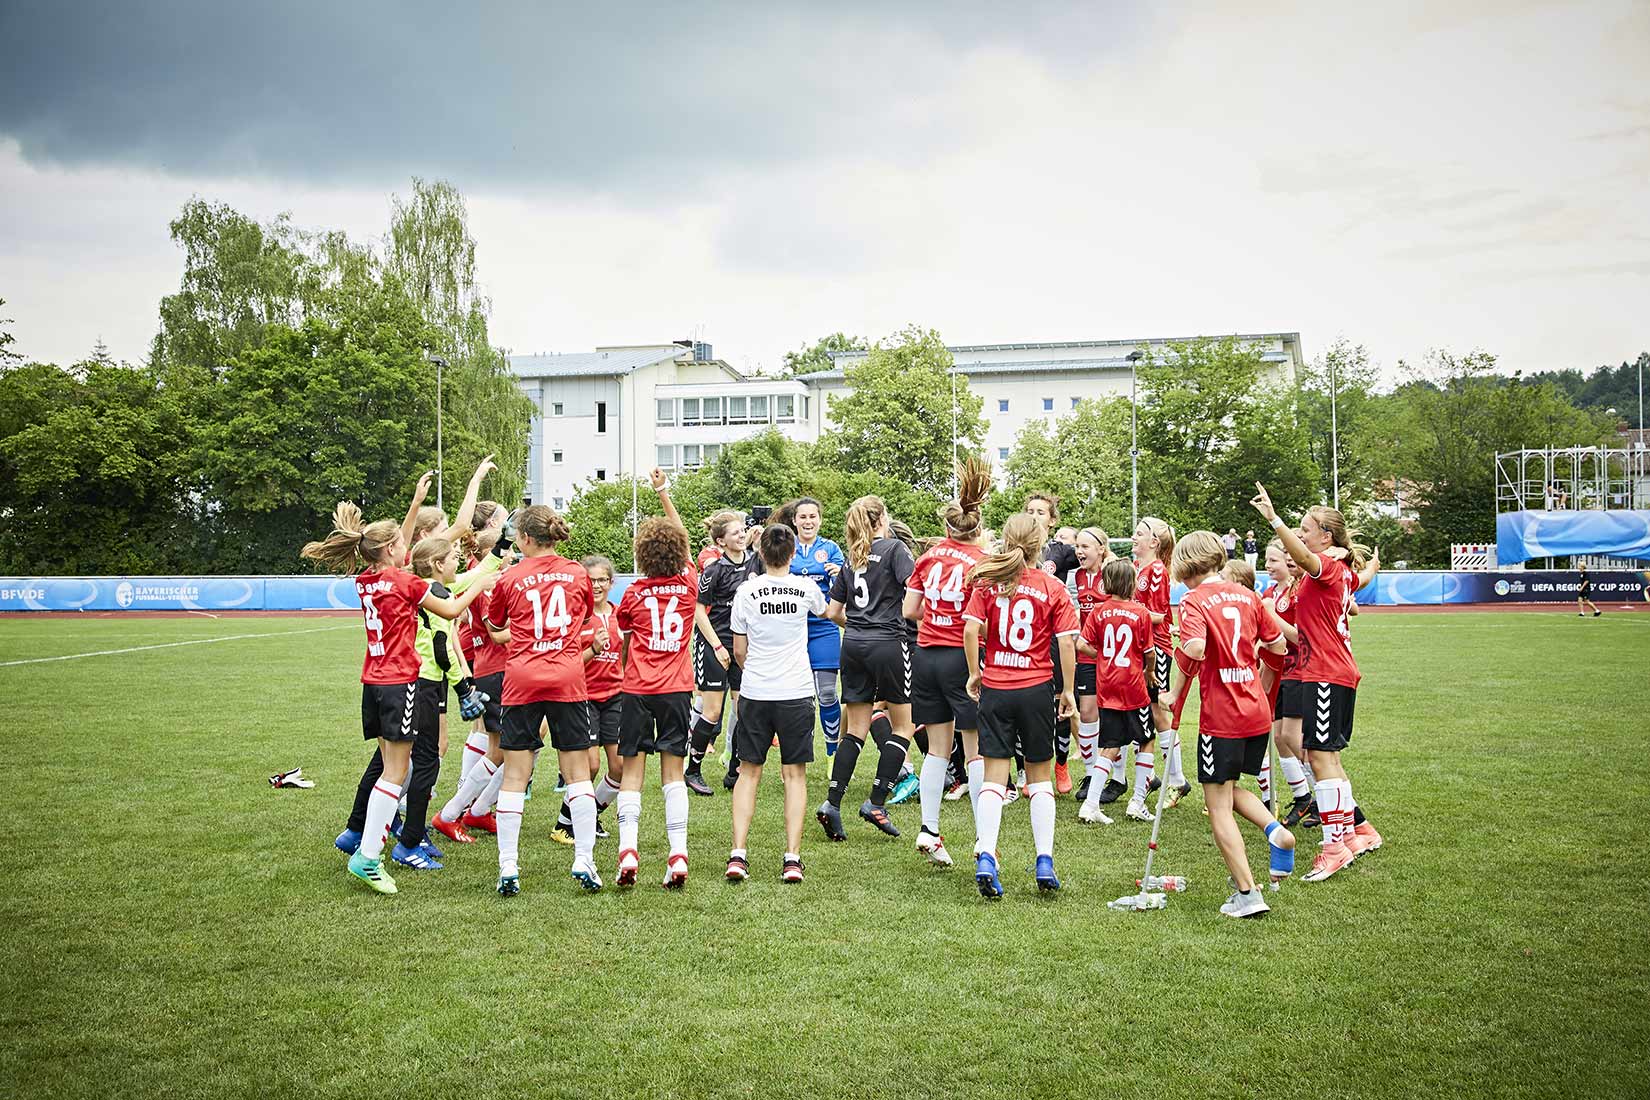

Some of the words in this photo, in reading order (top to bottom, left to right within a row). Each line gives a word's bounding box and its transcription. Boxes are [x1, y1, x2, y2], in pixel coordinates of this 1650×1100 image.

[946, 547, 976, 567] Passau
[523, 575, 536, 588] FC
[537, 572, 575, 584] Passau
[854, 567, 870, 609] 5
[923, 561, 965, 612] 44
[1531, 583, 1554, 592] UEFA
[1598, 583, 1617, 592] CUP
[1619, 582, 1641, 592] 2019
[2, 589, 46, 600] BFV.DE
[135, 587, 199, 595] BAYERISCHER
[652, 585, 688, 596] Passau
[750, 592, 759, 601] 1.
[758, 586, 769, 598] FC
[771, 586, 806, 598] Passau
[1208, 594, 1222, 606] FC
[1220, 591, 1252, 606] Passau
[526, 585, 572, 640] 14
[759, 601, 798, 615] Chello
[1103, 610, 1112, 619] FC
[1112, 608, 1139, 622] Passau
[363, 595, 383, 641] 4
[644, 596, 684, 641] 16
[995, 596, 1034, 652] 18
[1221, 606, 1241, 662] 7
[533, 639, 563, 652] Luisa
[1103, 623, 1133, 668] 42
[994, 650, 1032, 669] Müller
